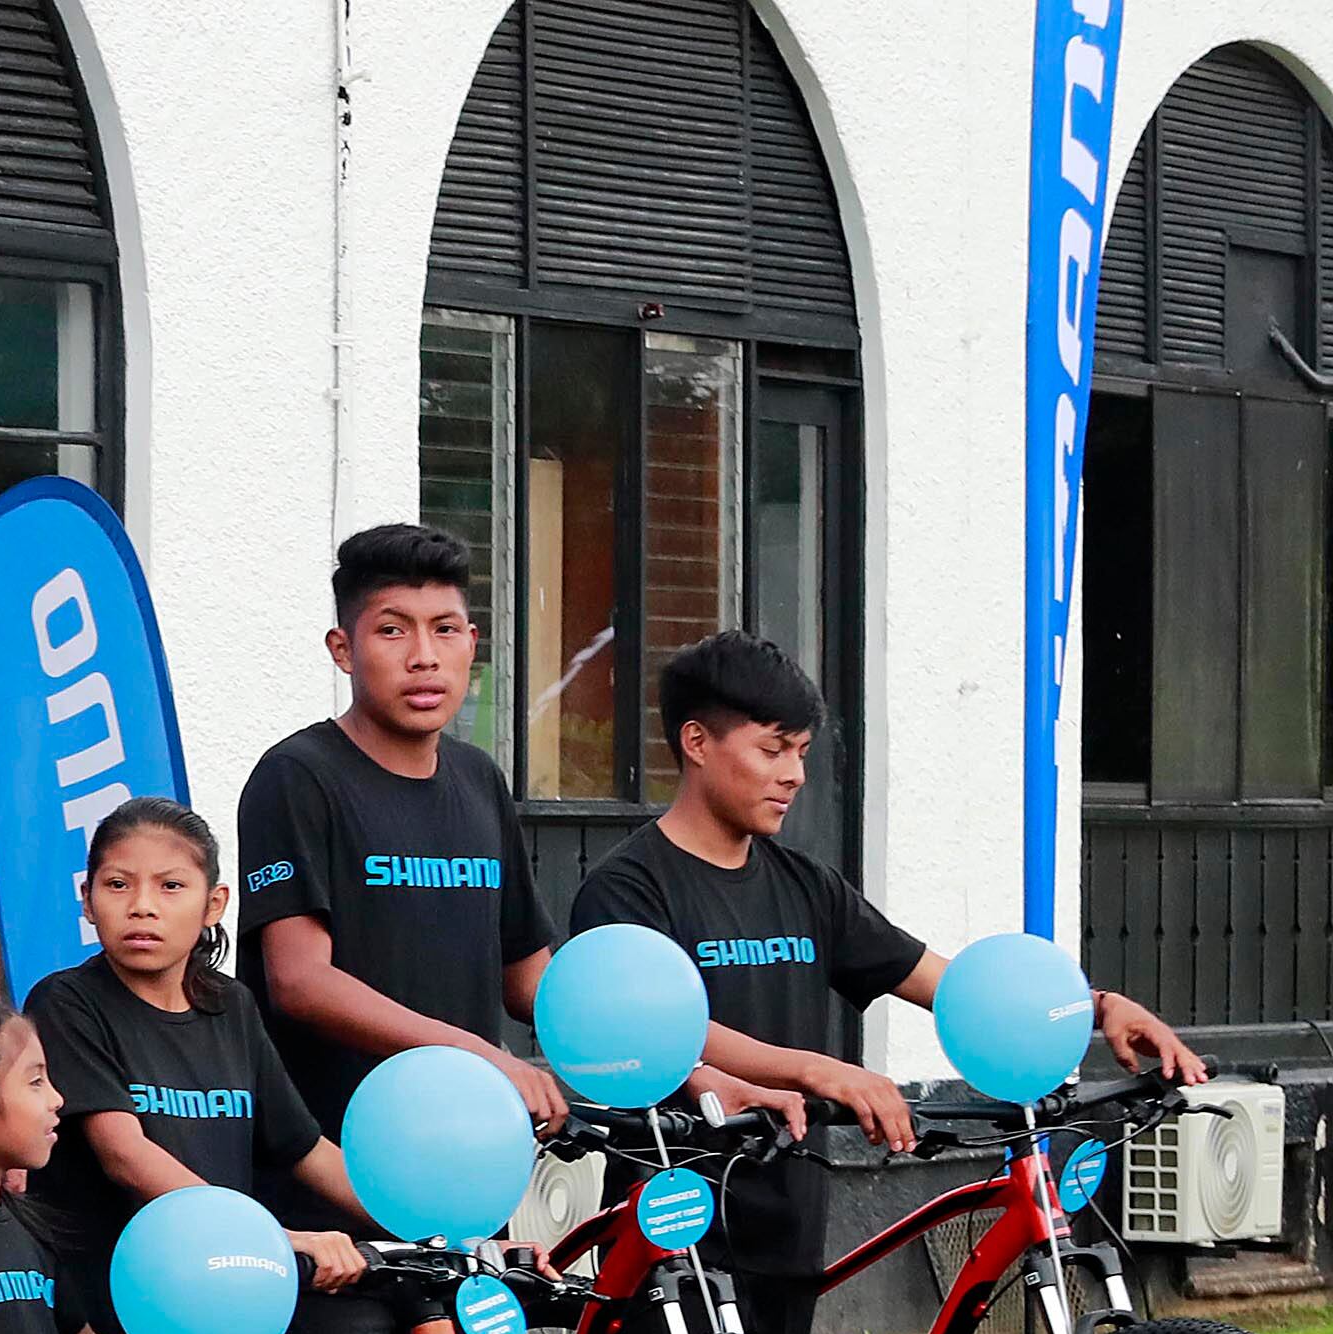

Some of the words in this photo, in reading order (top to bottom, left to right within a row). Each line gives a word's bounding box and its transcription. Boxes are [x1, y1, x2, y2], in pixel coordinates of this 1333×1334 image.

[247, 860, 295, 892] PRO
[366, 855, 501, 889] SHIMANO
[129, 1083, 253, 1120] SHIMAN
[208, 1255, 288, 1278] SHIMANO
